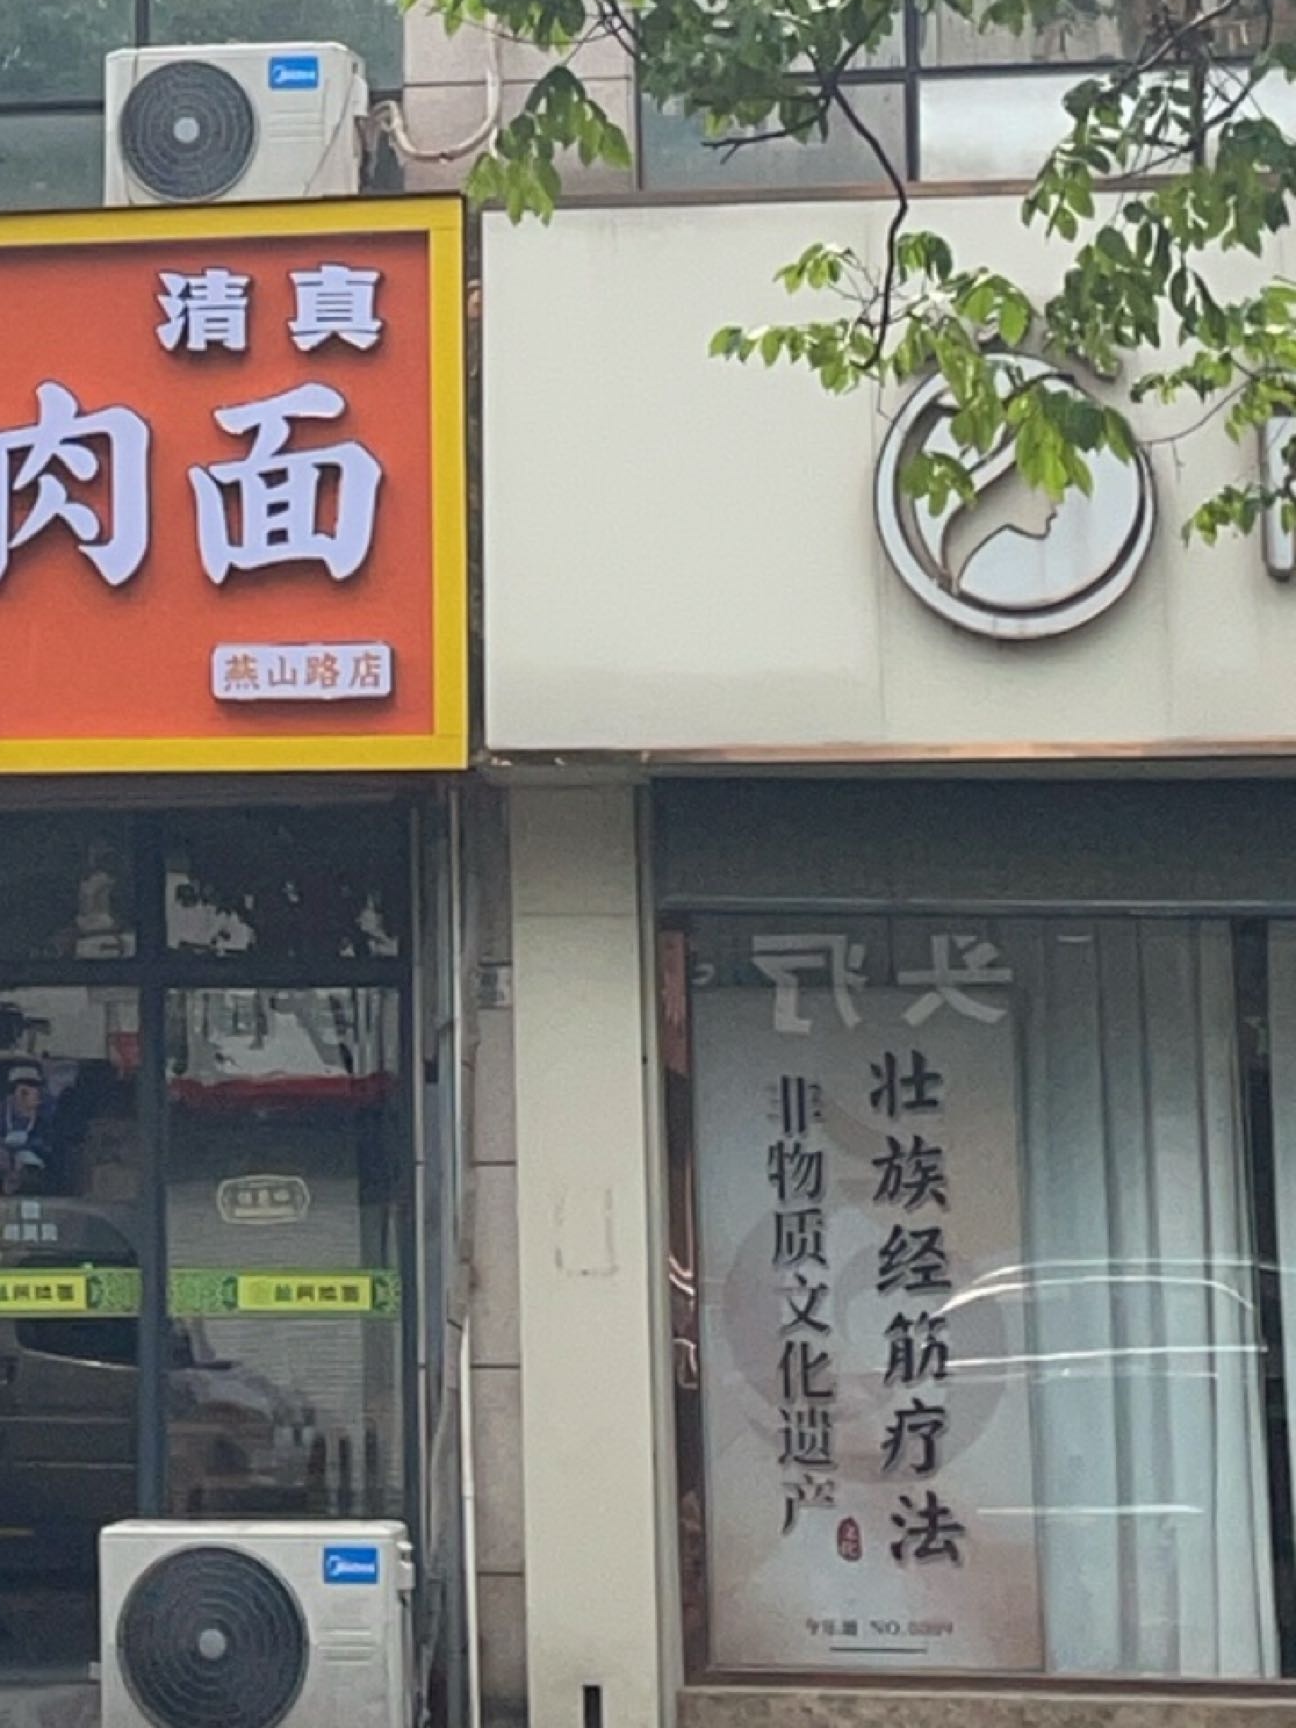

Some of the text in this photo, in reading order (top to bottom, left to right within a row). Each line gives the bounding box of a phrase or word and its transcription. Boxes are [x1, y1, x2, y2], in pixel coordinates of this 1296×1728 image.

[155, 263, 384, 352] 清真
[221, 650, 384, 692] 燕山路店
[767, 1074, 835, 1537] 非物质文化遗产
[869, 1049, 965, 1568] 壮族经筋疗法
